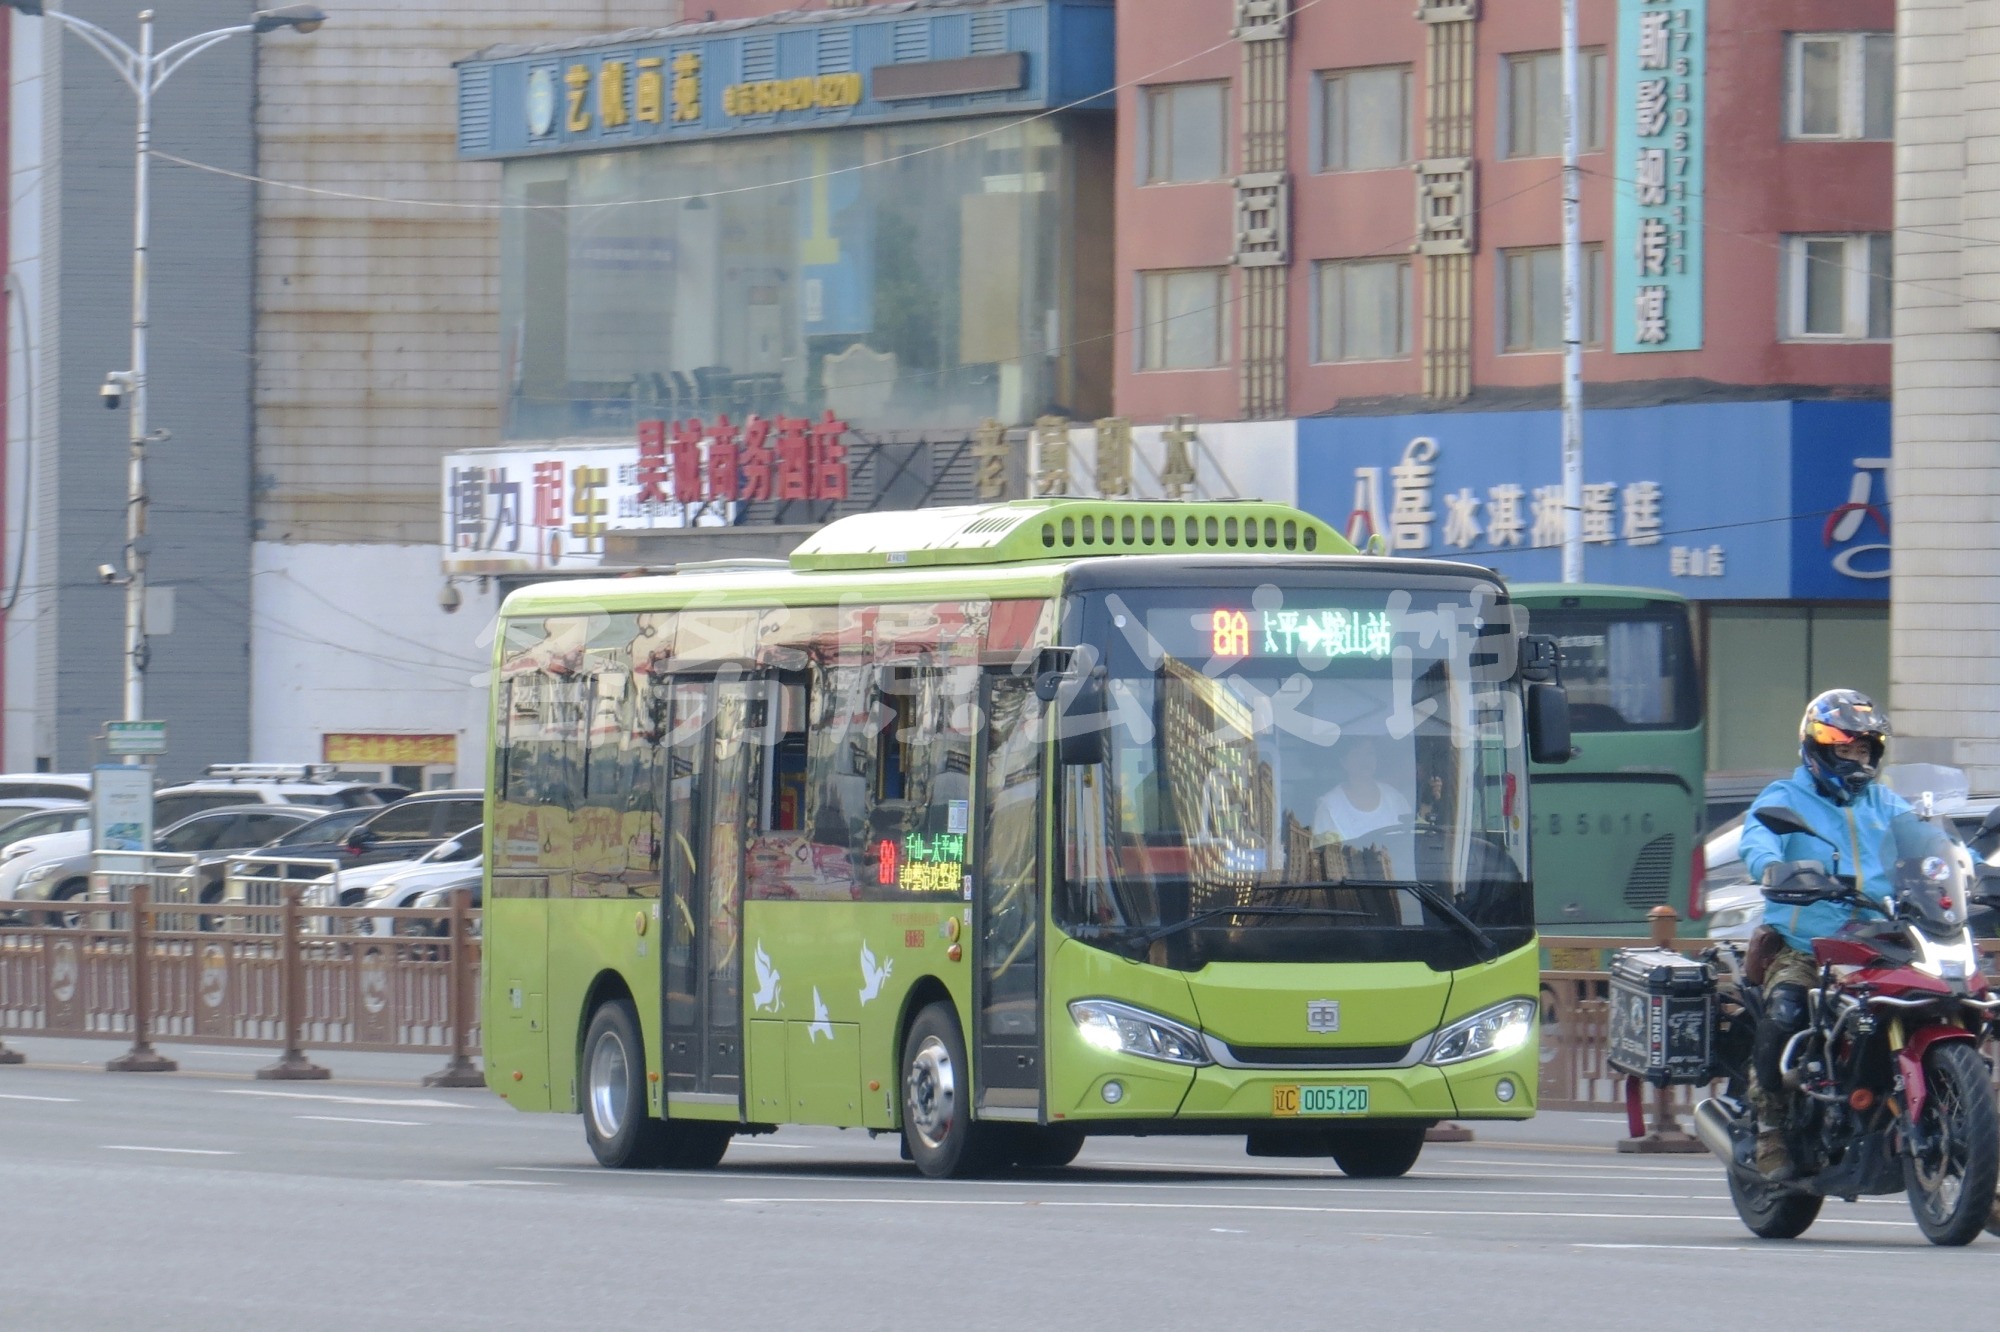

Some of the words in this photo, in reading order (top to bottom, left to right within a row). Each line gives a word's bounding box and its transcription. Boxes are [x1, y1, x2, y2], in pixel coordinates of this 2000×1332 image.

[1635, 0, 1671, 345] 斯影视传媒
[450, 459, 610, 555] 博为租车
[1212, 609, 1250, 656] 8A
